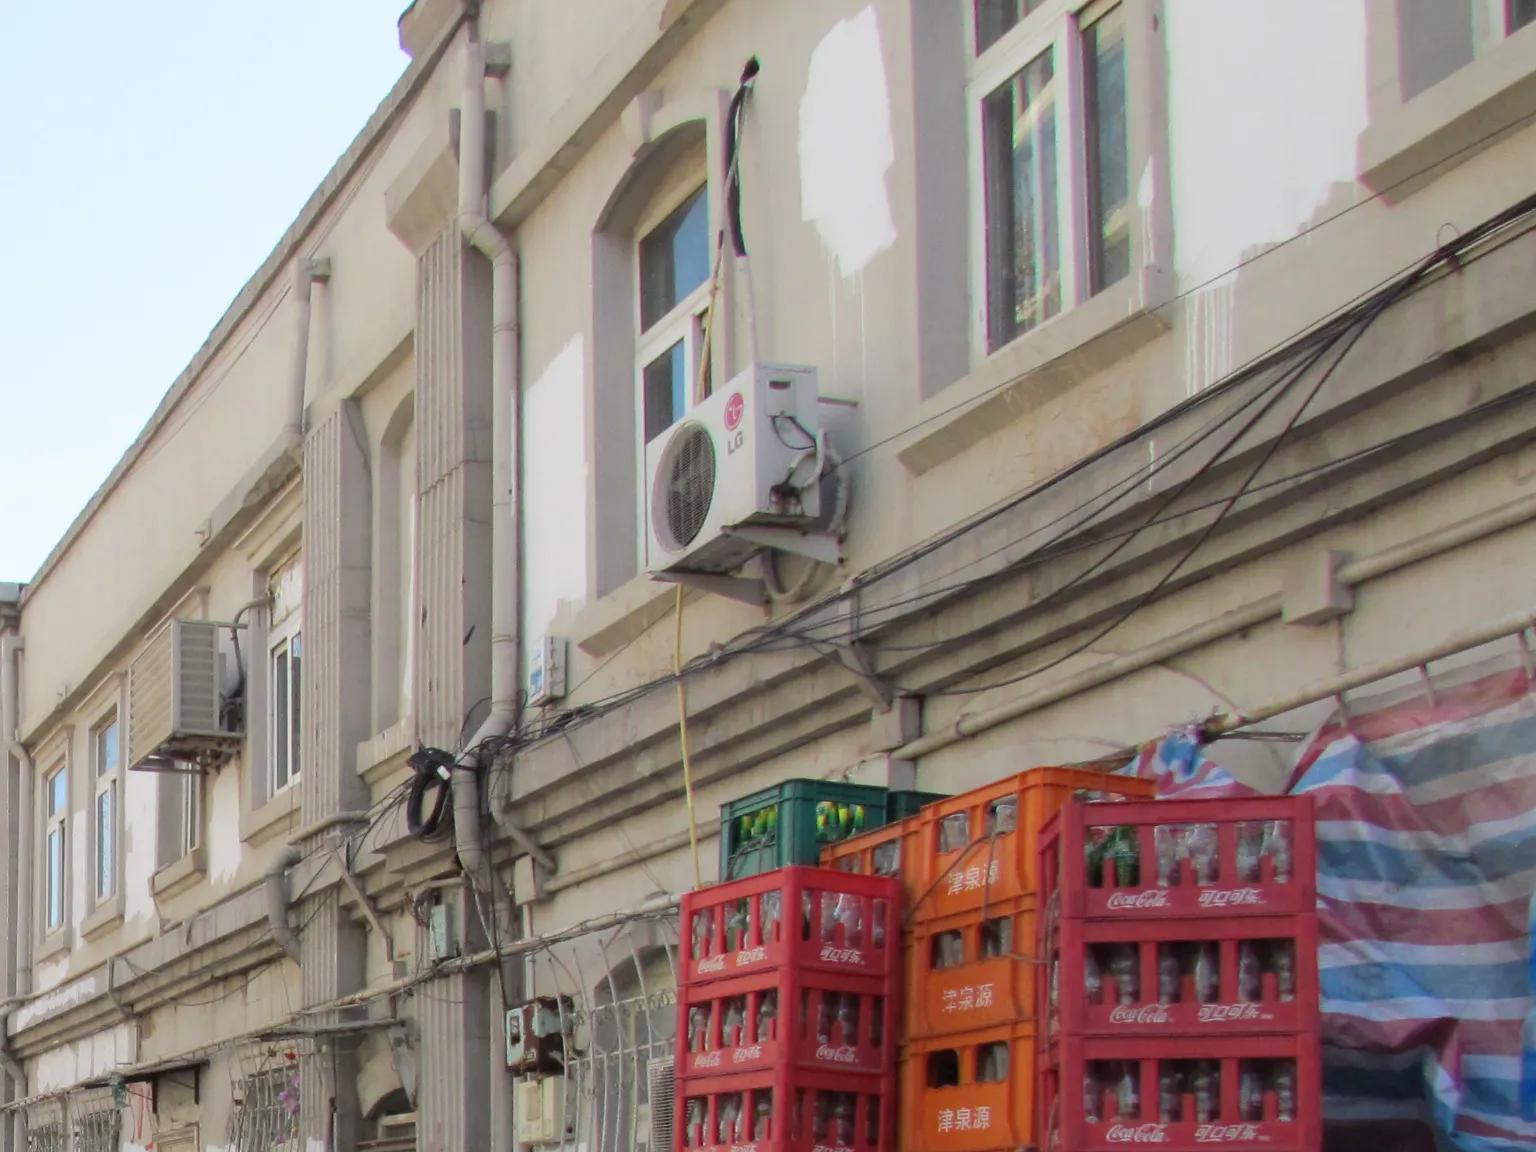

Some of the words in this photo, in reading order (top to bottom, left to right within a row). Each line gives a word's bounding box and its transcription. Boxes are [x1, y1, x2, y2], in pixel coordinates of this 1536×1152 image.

[727, 431, 743, 454] LG
[1197, 888, 1262, 908] 可口可乐
[1197, 1003, 1260, 1022] 可口可乐
[938, 1106, 991, 1132] 津泉源
[1195, 1124, 1259, 1142] 可口可乐
